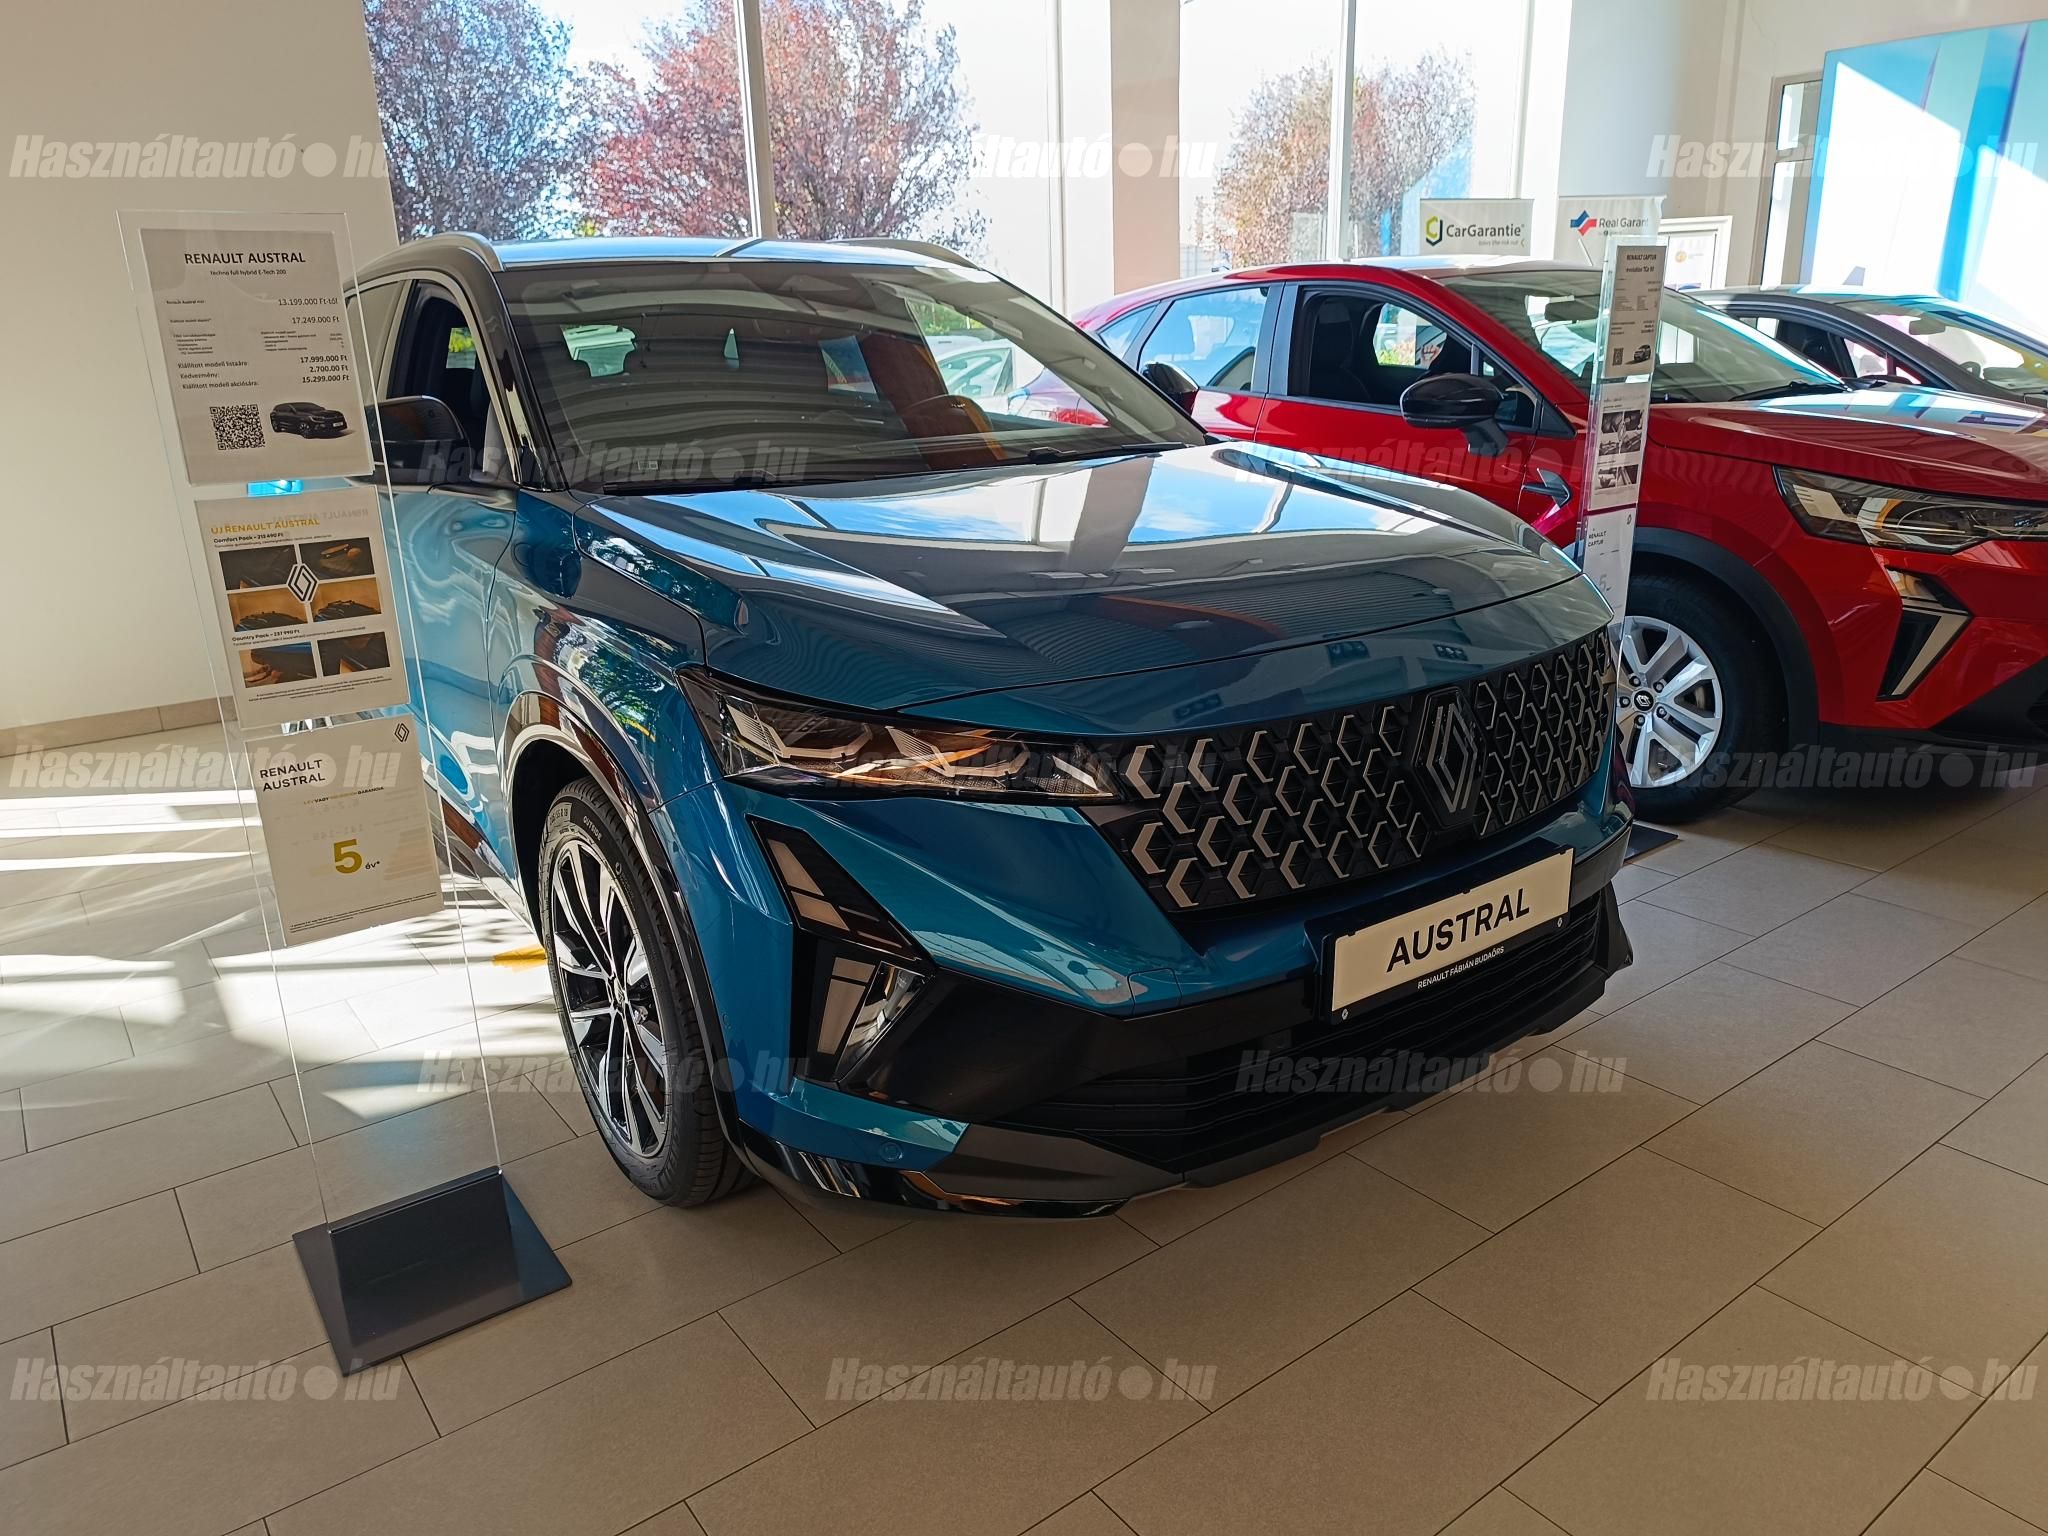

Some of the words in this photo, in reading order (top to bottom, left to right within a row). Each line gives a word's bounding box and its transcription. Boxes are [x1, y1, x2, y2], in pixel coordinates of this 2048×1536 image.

[1599, 217, 1619, 228] Real
[184, 253, 244, 264] RENAULT
[248, 252, 306, 264] AUSTRAL
[292, 316, 331, 325] 17.249.000
[300, 355, 339, 363] 17.999.000
[309, 365, 340, 373] 2.700.00
[302, 374, 341, 384] 15.299.000
[342, 374, 350, 382] Ft
[224, 522, 273, 533] RENAULT
[274, 518, 321, 529] AUSTRAL
[259, 759, 322, 779] RENAULT
[262, 772, 325, 792] AUSTRAL
[334, 838, 363, 874] 5
[1386, 887, 1530, 973] AUSTRAL
[1417, 969, 1449, 990] RENAULT
[1449, 958, 1475, 977] FÁBIÁN
